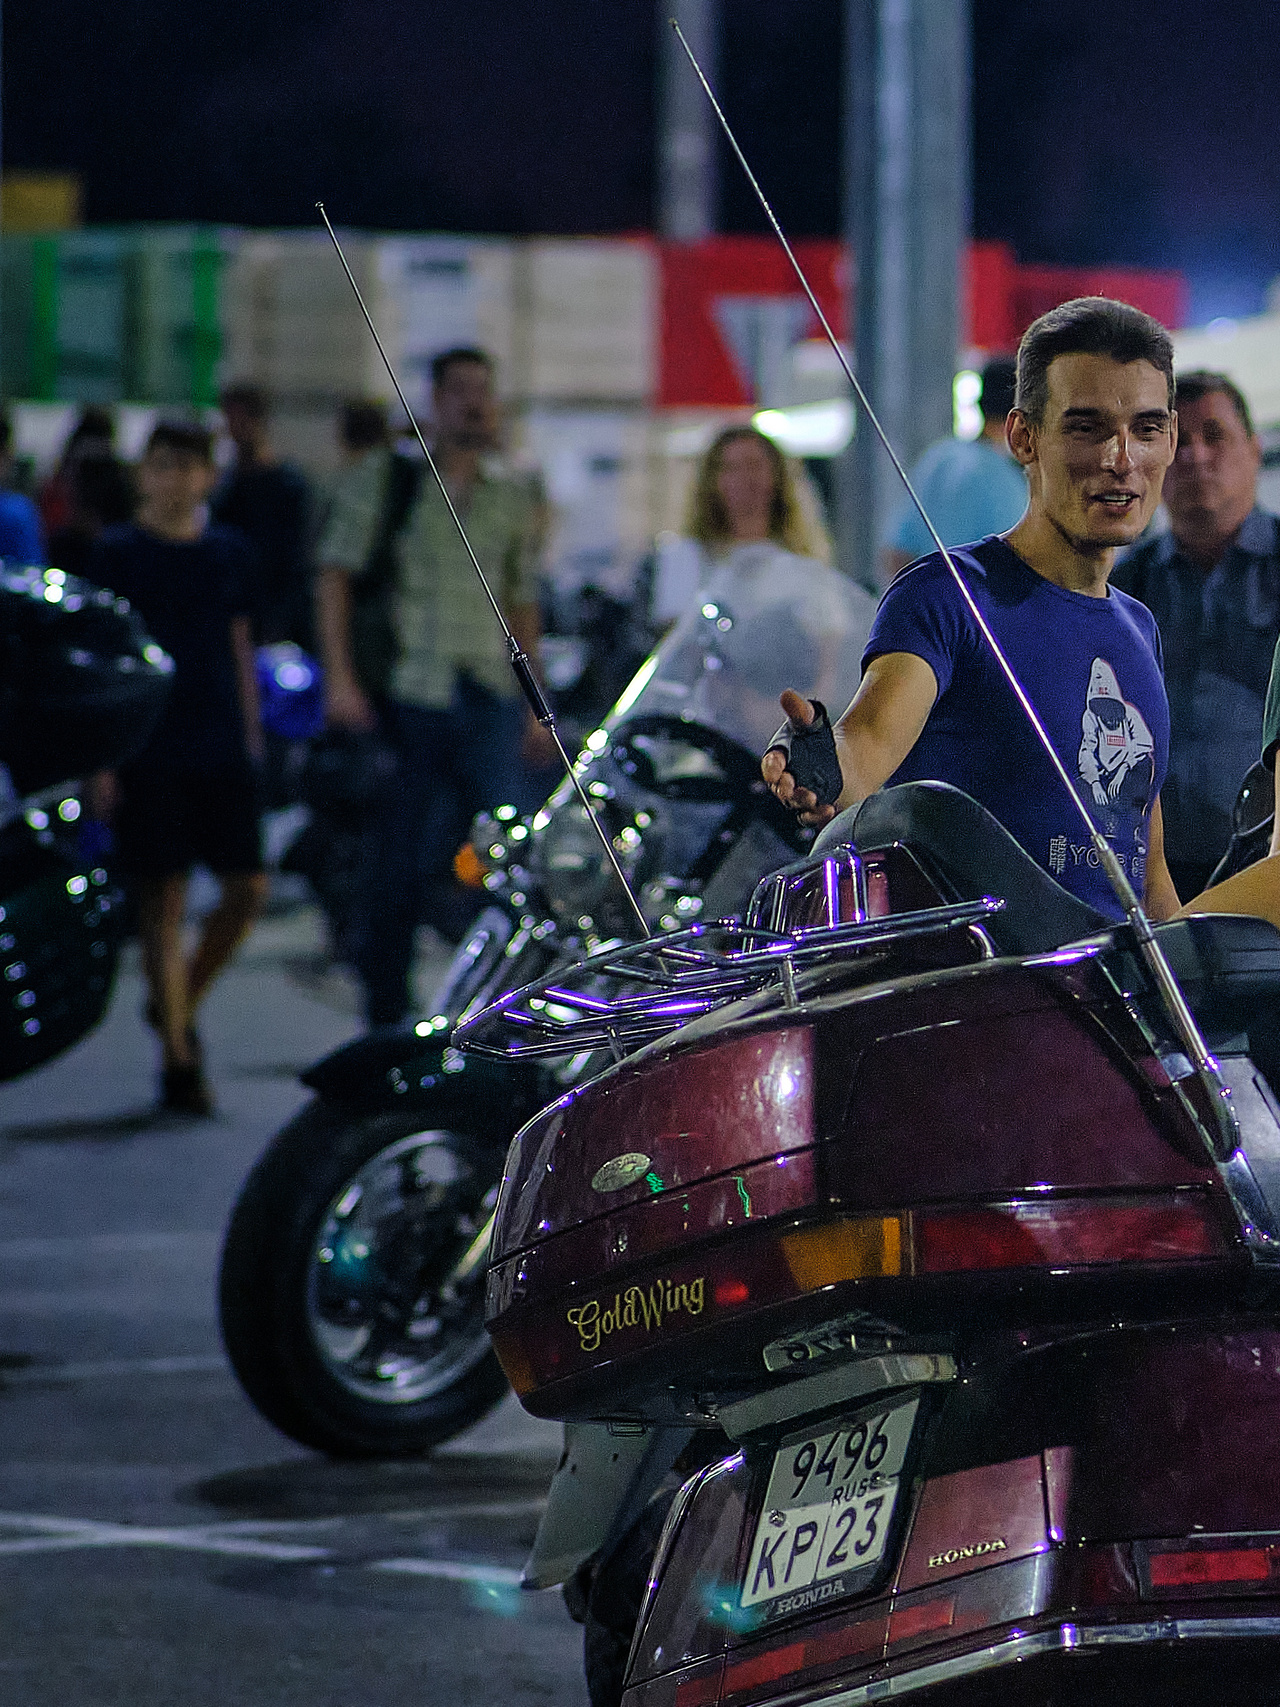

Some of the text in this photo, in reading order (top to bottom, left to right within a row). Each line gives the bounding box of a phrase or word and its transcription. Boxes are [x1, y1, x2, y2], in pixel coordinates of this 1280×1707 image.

[567, 1277, 705, 1352] GoldWing
[790, 1412, 891, 1500] 9496
[826, 1494, 886, 1569] 23
[927, 1537, 1008, 1569] HONDA
[776, 1578, 846, 1615] HONDA
